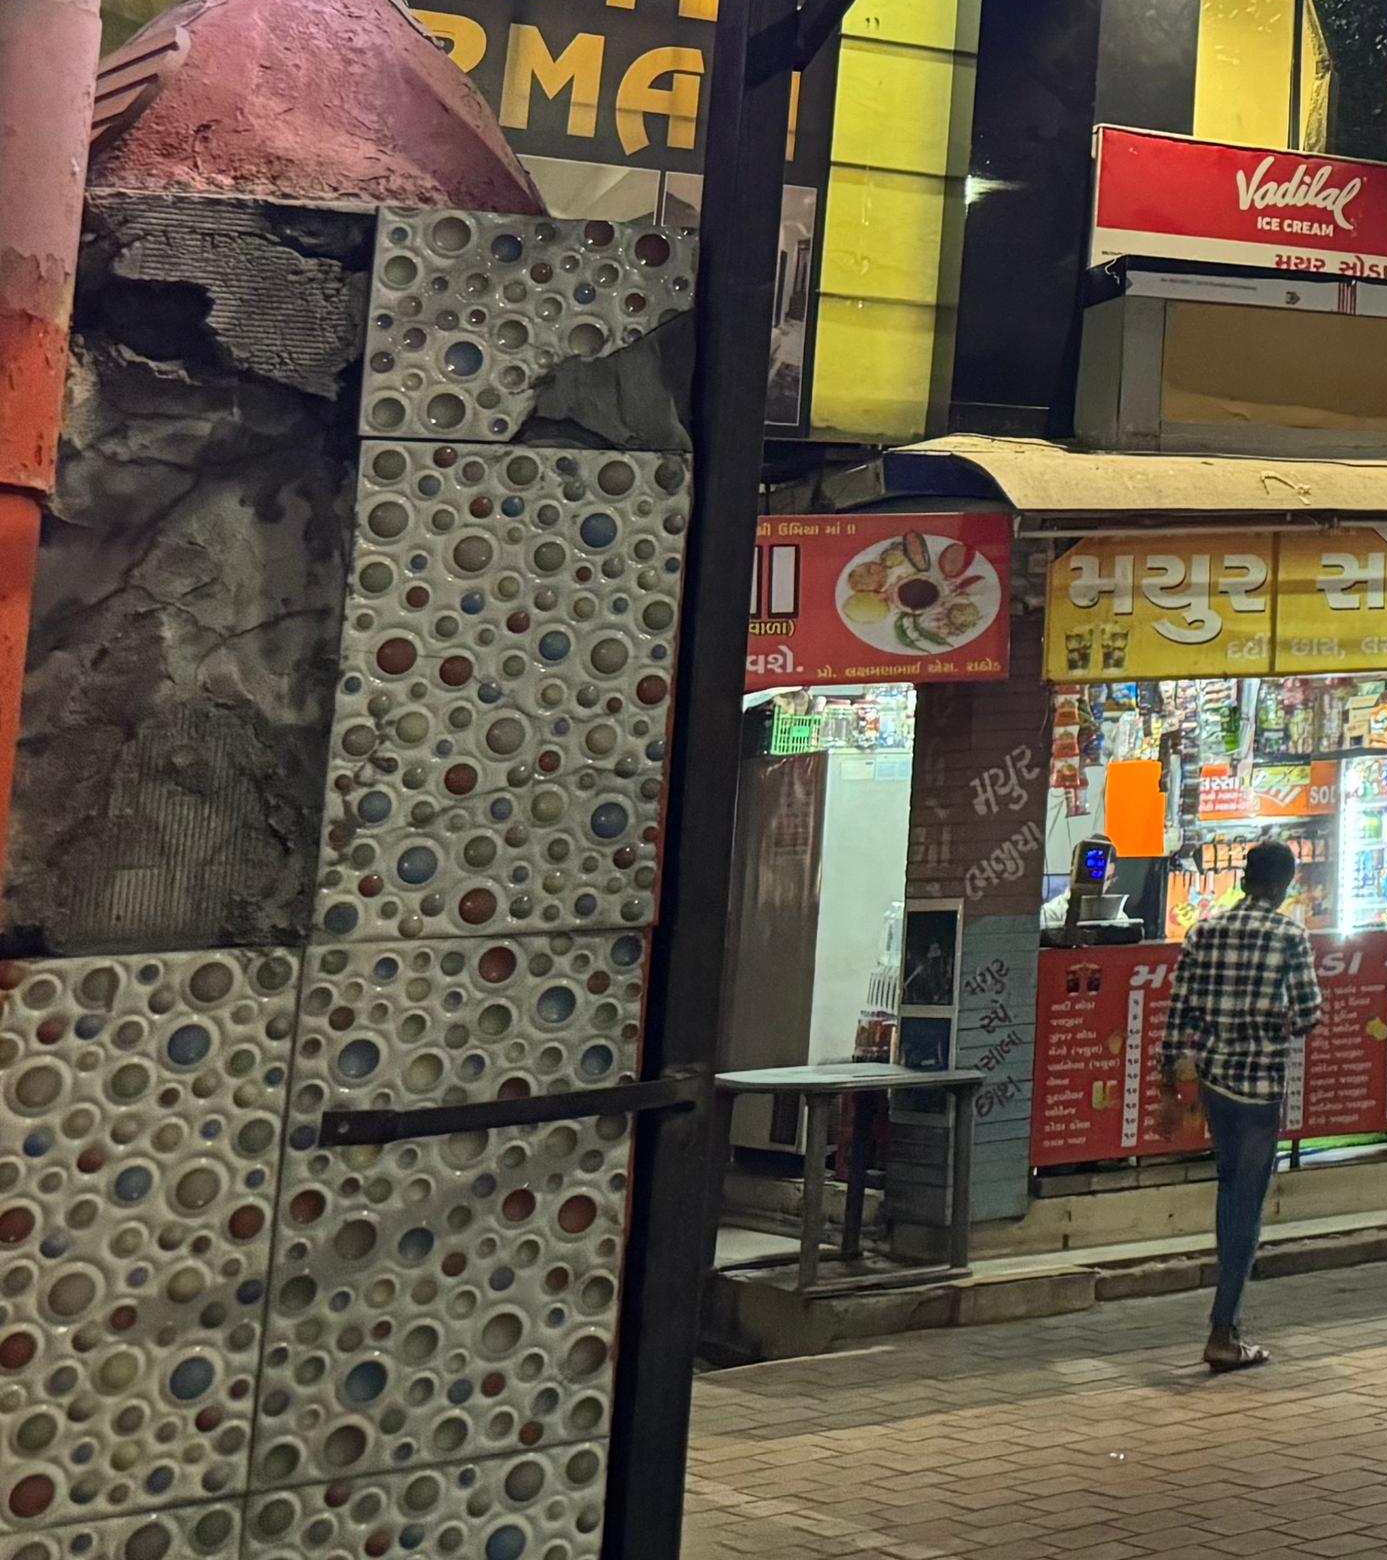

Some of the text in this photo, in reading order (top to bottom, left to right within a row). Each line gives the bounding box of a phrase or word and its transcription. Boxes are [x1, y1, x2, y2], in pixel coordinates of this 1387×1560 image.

[1235, 156, 1362, 231] Vadilal
[1256, 214, 1334, 238] ICE CREAM
[1068, 553, 1269, 645] મયુર
